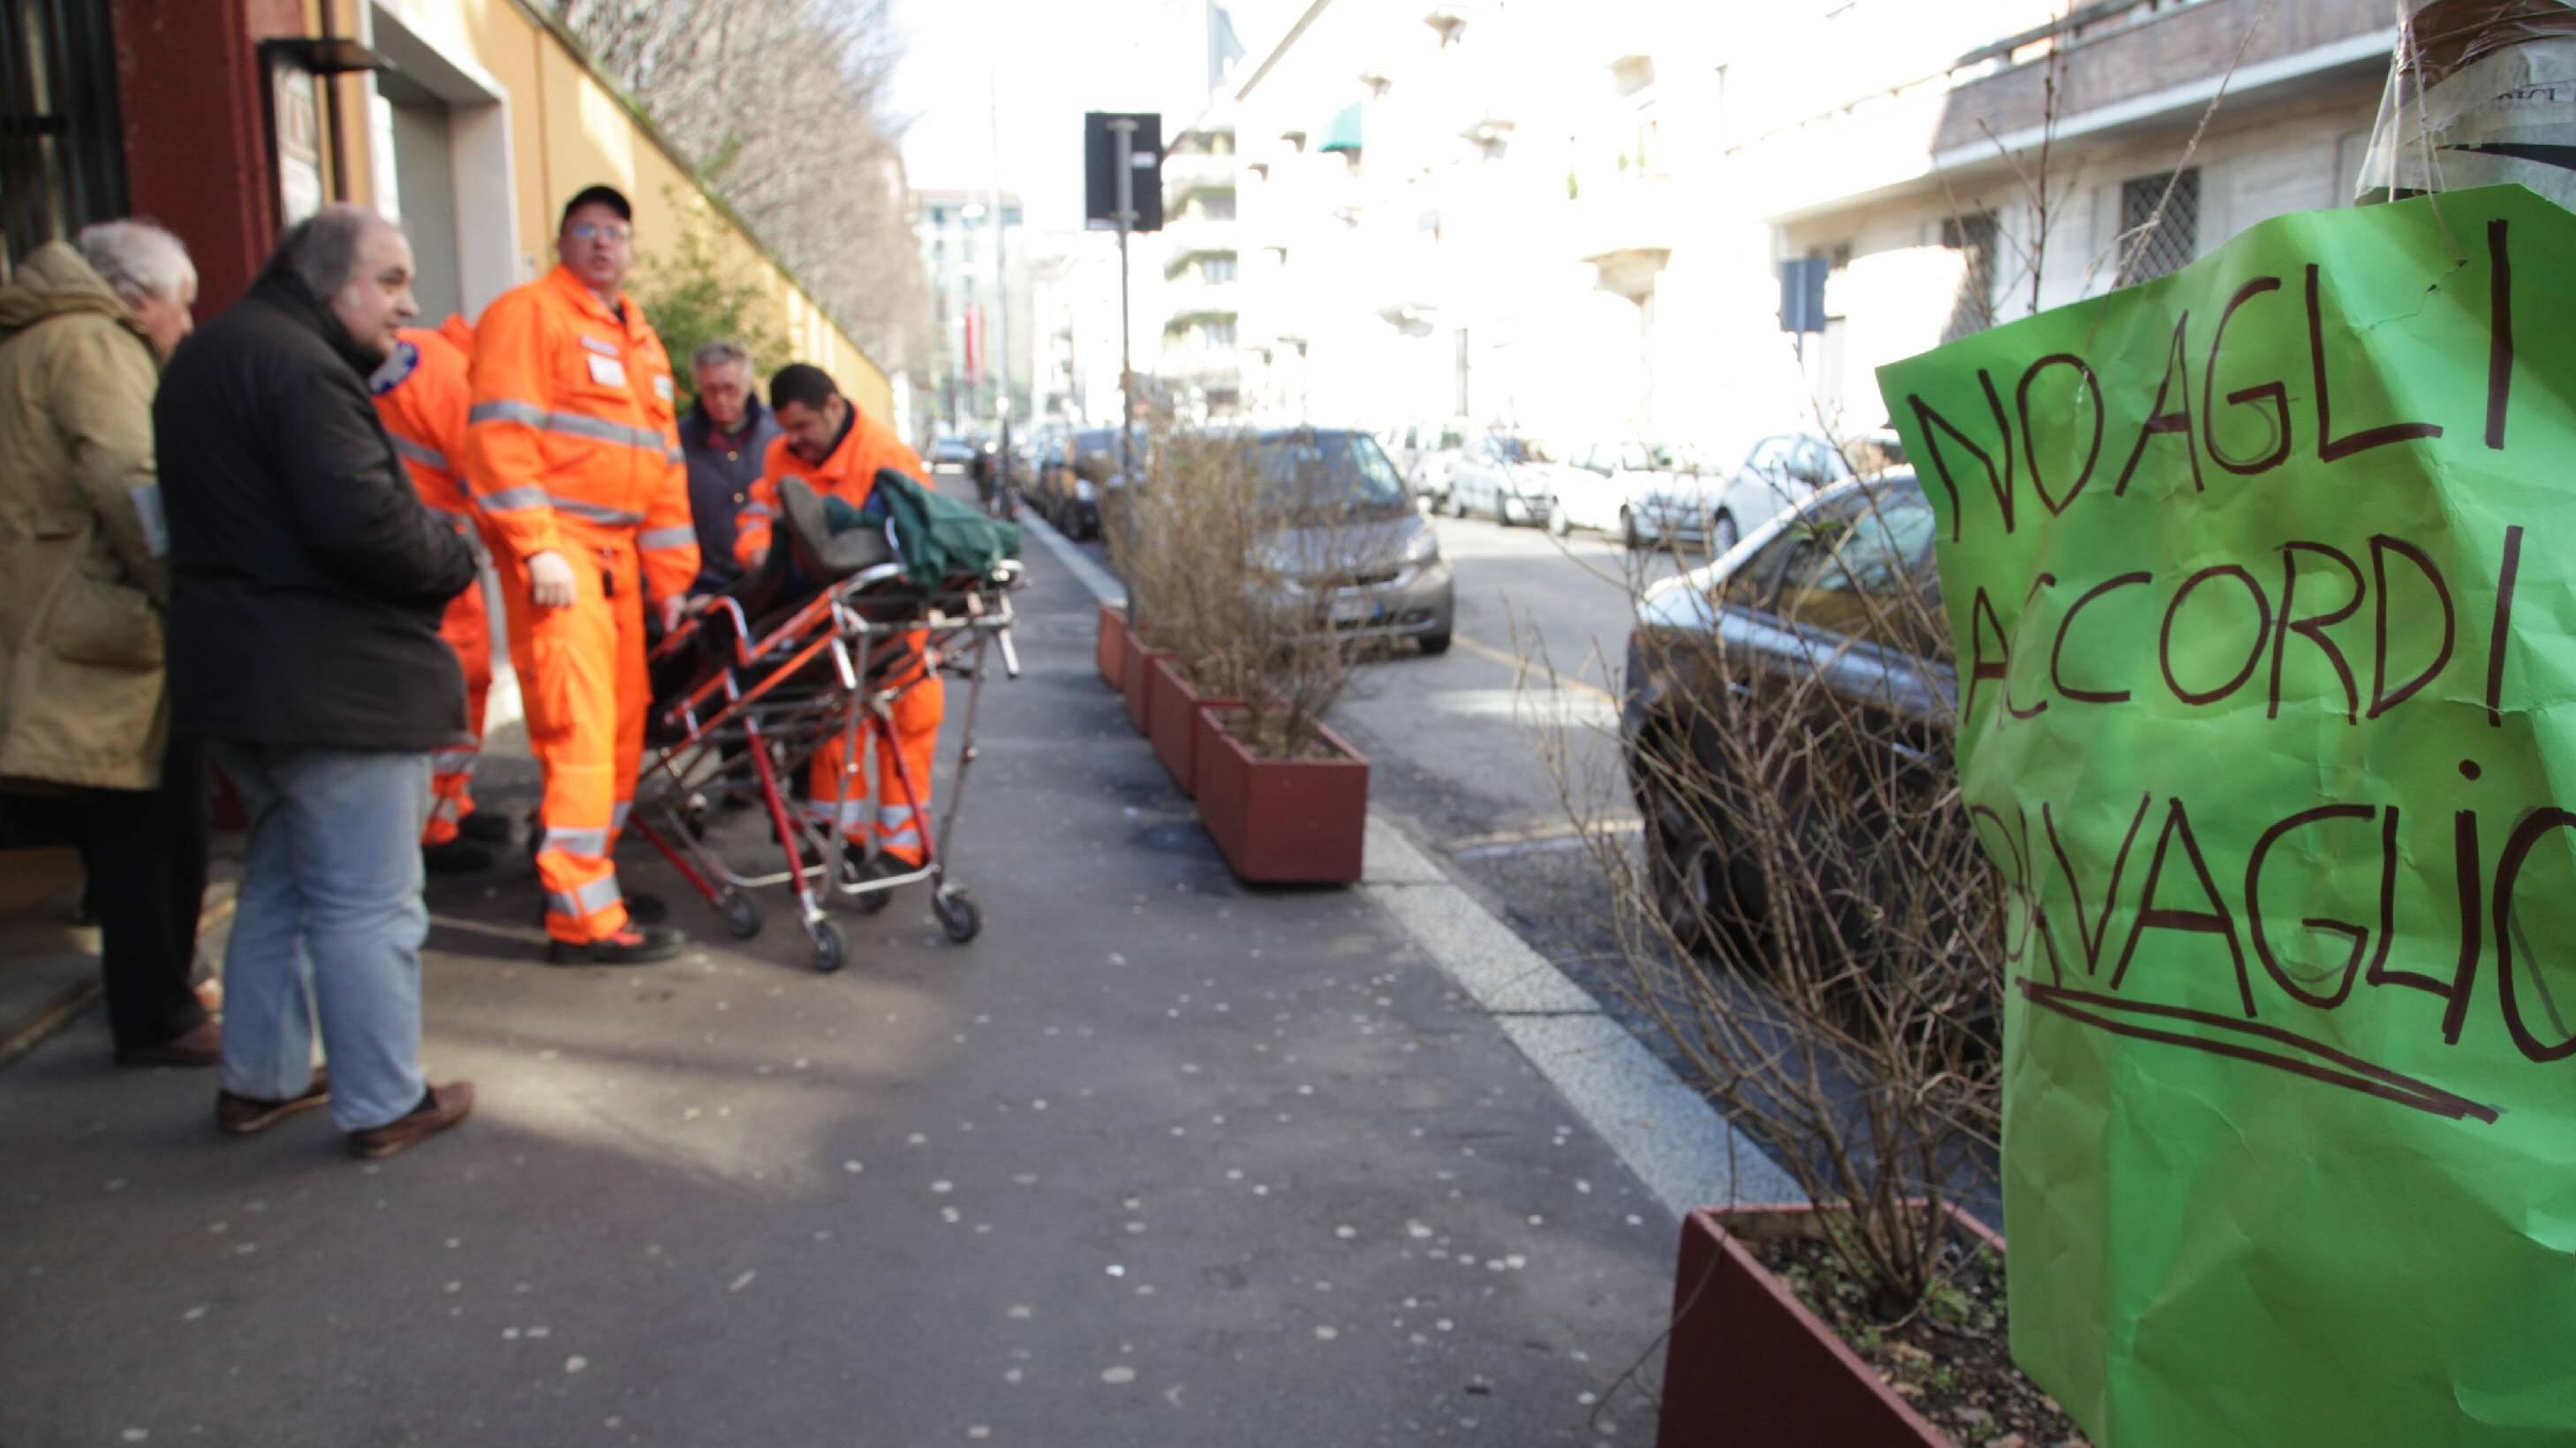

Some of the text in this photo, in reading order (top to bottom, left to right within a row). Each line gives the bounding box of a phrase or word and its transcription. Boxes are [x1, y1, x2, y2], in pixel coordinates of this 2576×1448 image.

[1907, 218, 2514, 543] NO AGLI
[1963, 524, 2524, 728] ACCORDI
